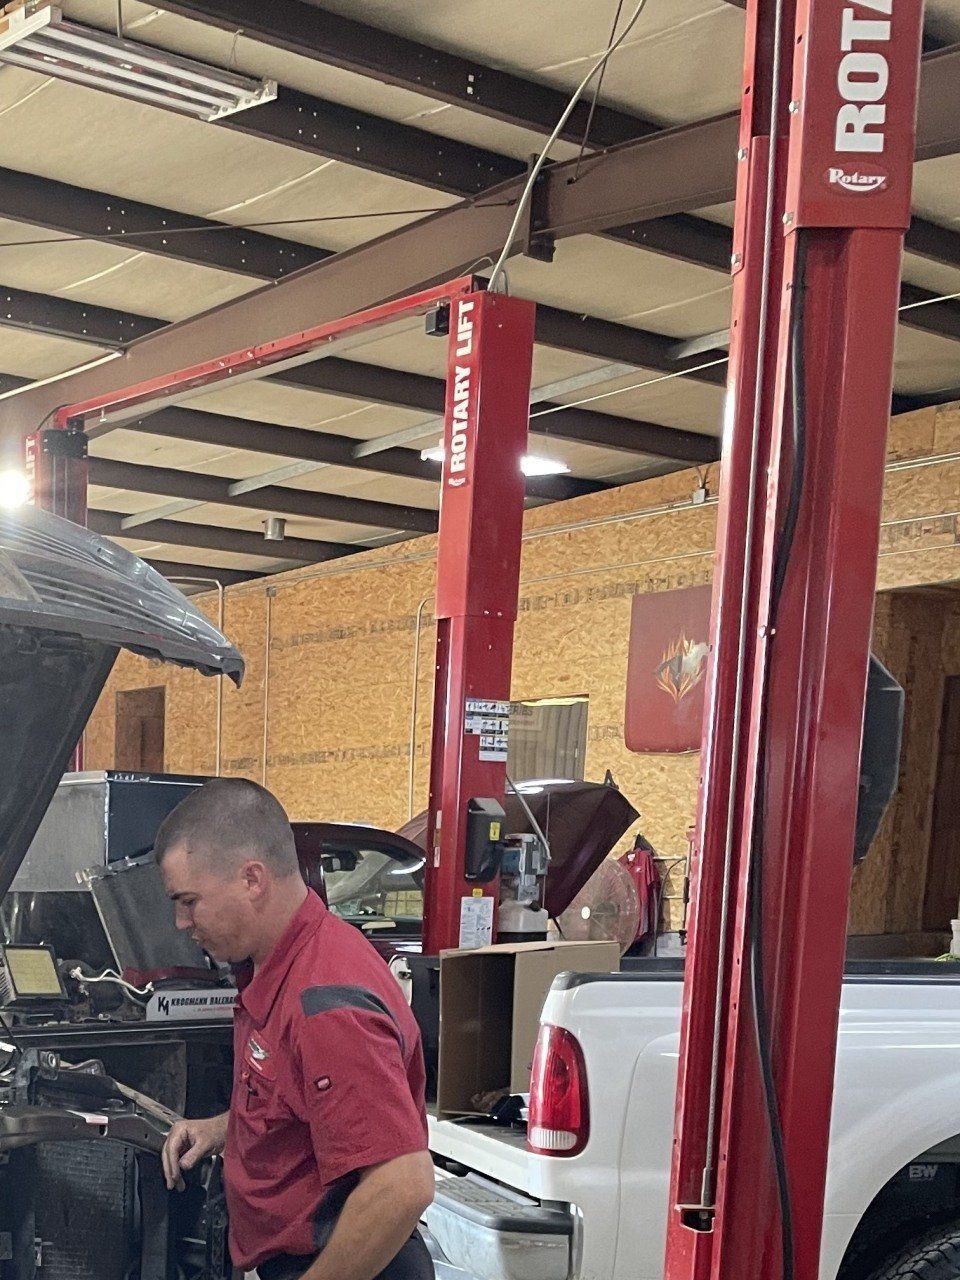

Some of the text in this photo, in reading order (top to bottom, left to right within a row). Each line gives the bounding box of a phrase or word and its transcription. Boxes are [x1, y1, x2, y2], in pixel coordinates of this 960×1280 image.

[835, 0, 892, 152] ROT
[828, 167, 886, 187] Rotary
[450, 300, 475, 474] ROTARY LIFT
